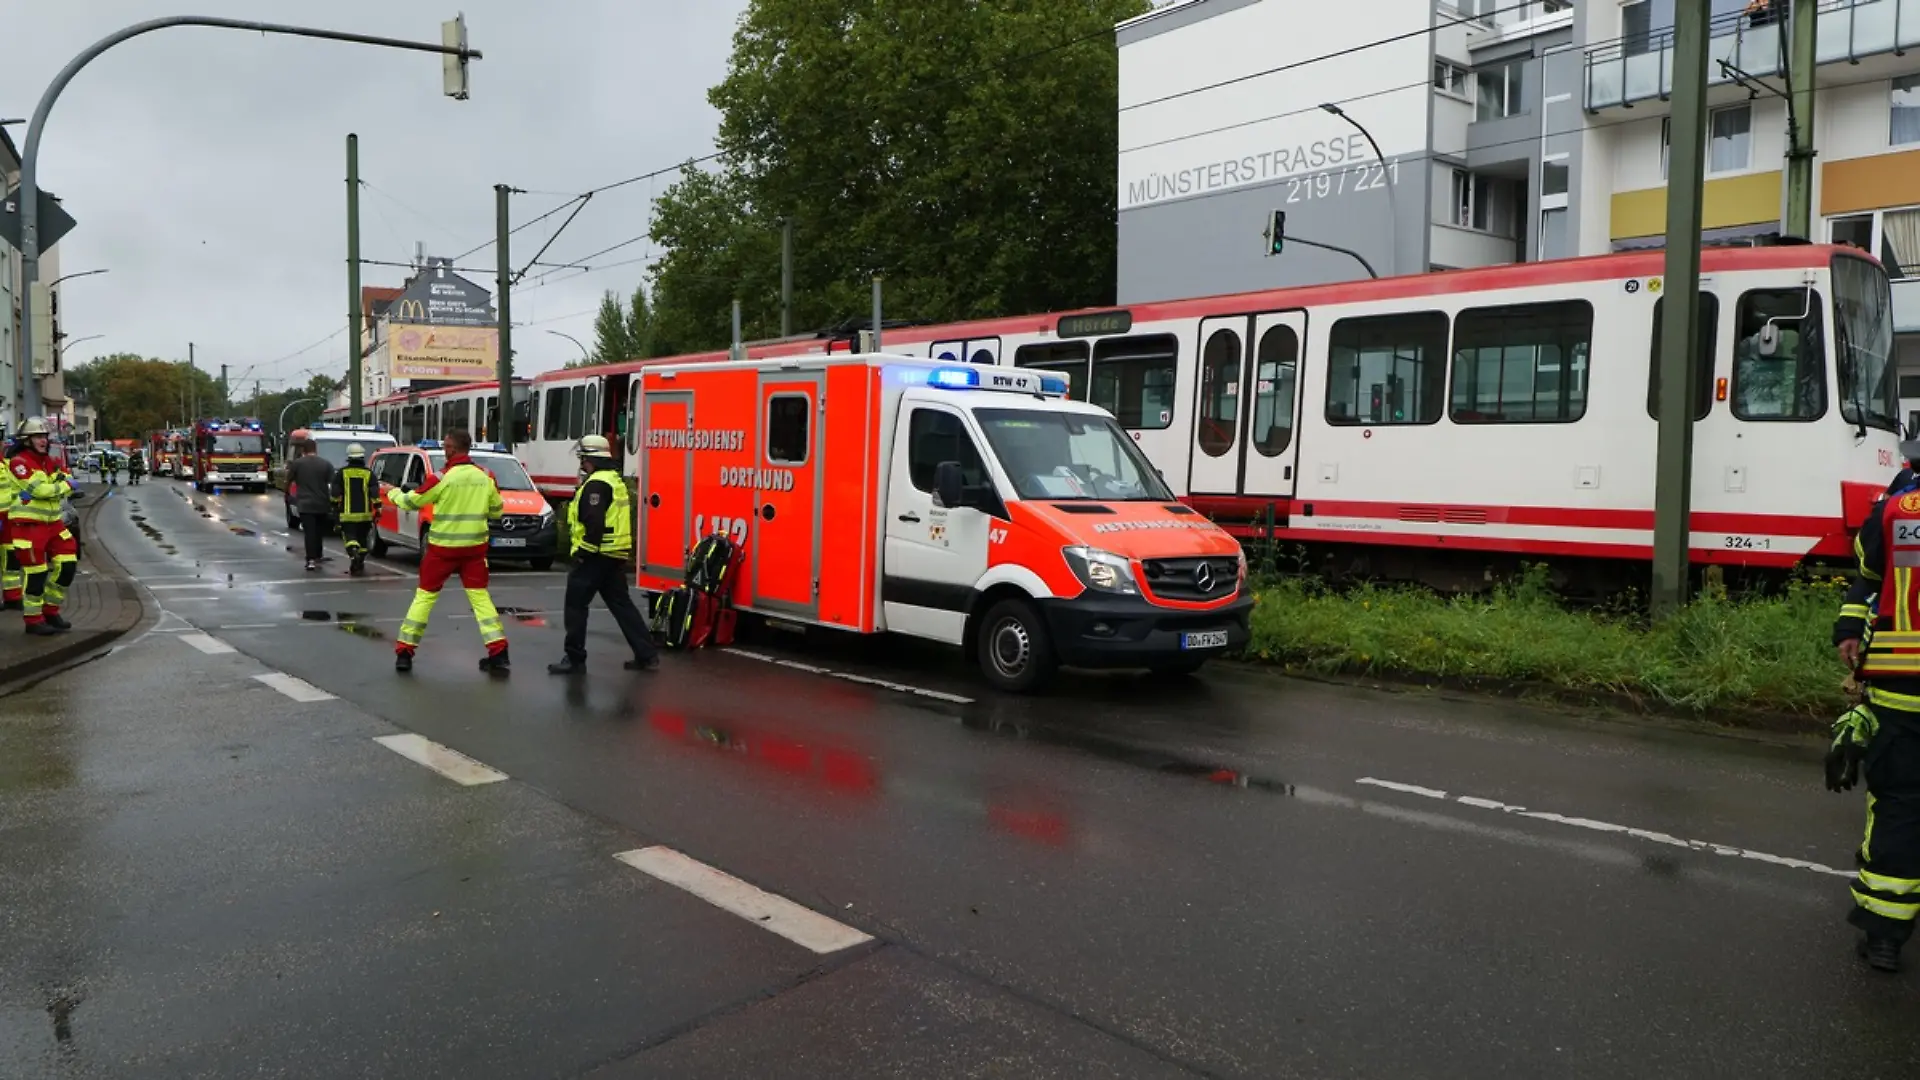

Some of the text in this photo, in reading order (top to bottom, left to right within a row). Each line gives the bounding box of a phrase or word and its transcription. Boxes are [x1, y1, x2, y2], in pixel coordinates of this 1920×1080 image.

[1129, 133, 1364, 204] MÜNSTERSTRASSE
[1286, 173, 1330, 204] 219
[1354, 159, 1399, 192] 221
[1073, 317, 1119, 332] Hörde
[993, 376, 1028, 388] RTW 47
[645, 429, 745, 451] RETTUNGSDIENST
[720, 466, 794, 491] DORTMUND
[990, 528, 1008, 544] 47
